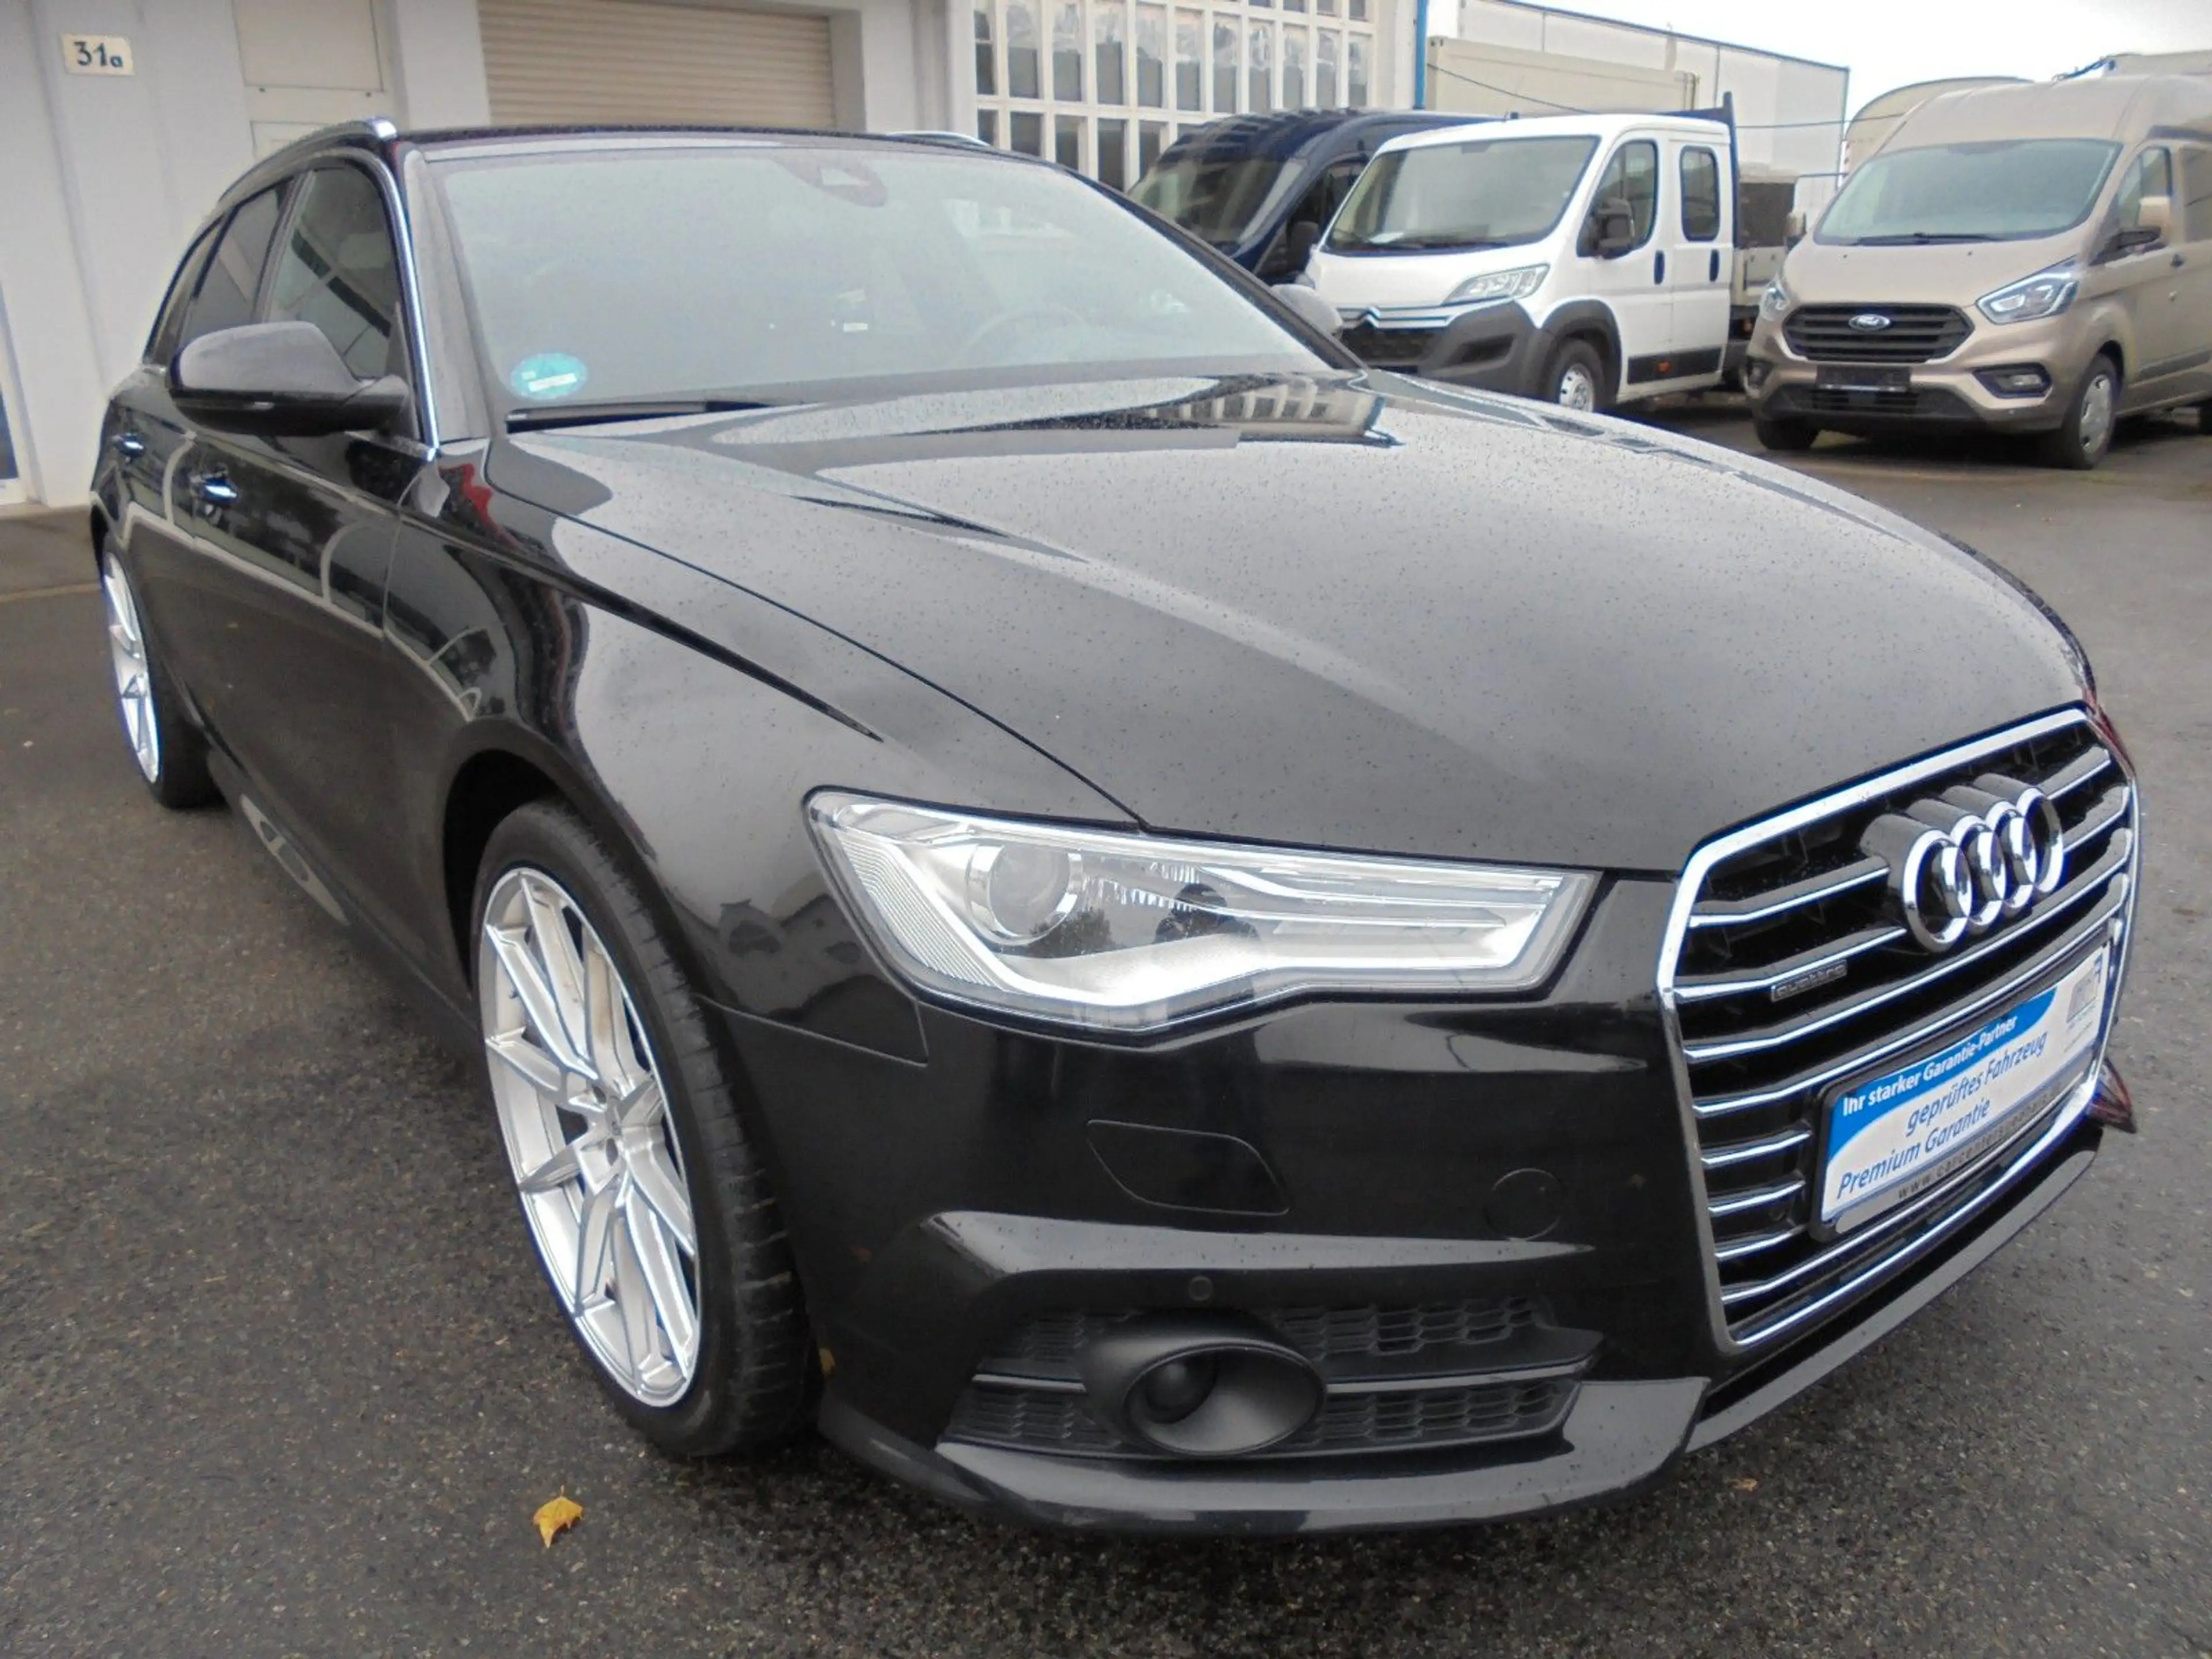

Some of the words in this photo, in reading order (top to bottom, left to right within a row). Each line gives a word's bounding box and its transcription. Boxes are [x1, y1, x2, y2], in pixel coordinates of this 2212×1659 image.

[74, 41, 123, 67] 31a
[1843, 1097, 1866, 1116] Ihr
[1868, 1071, 1922, 1106] starker
[1923, 1016, 2018, 1081] Garantie-Partner
[1906, 1071, 1983, 1137] geprüftes
[1984, 1031, 2047, 1084] Fahrzeug
[1836, 1143, 1921, 1199] Premium
[1925, 1098, 1991, 1152] Garantie
